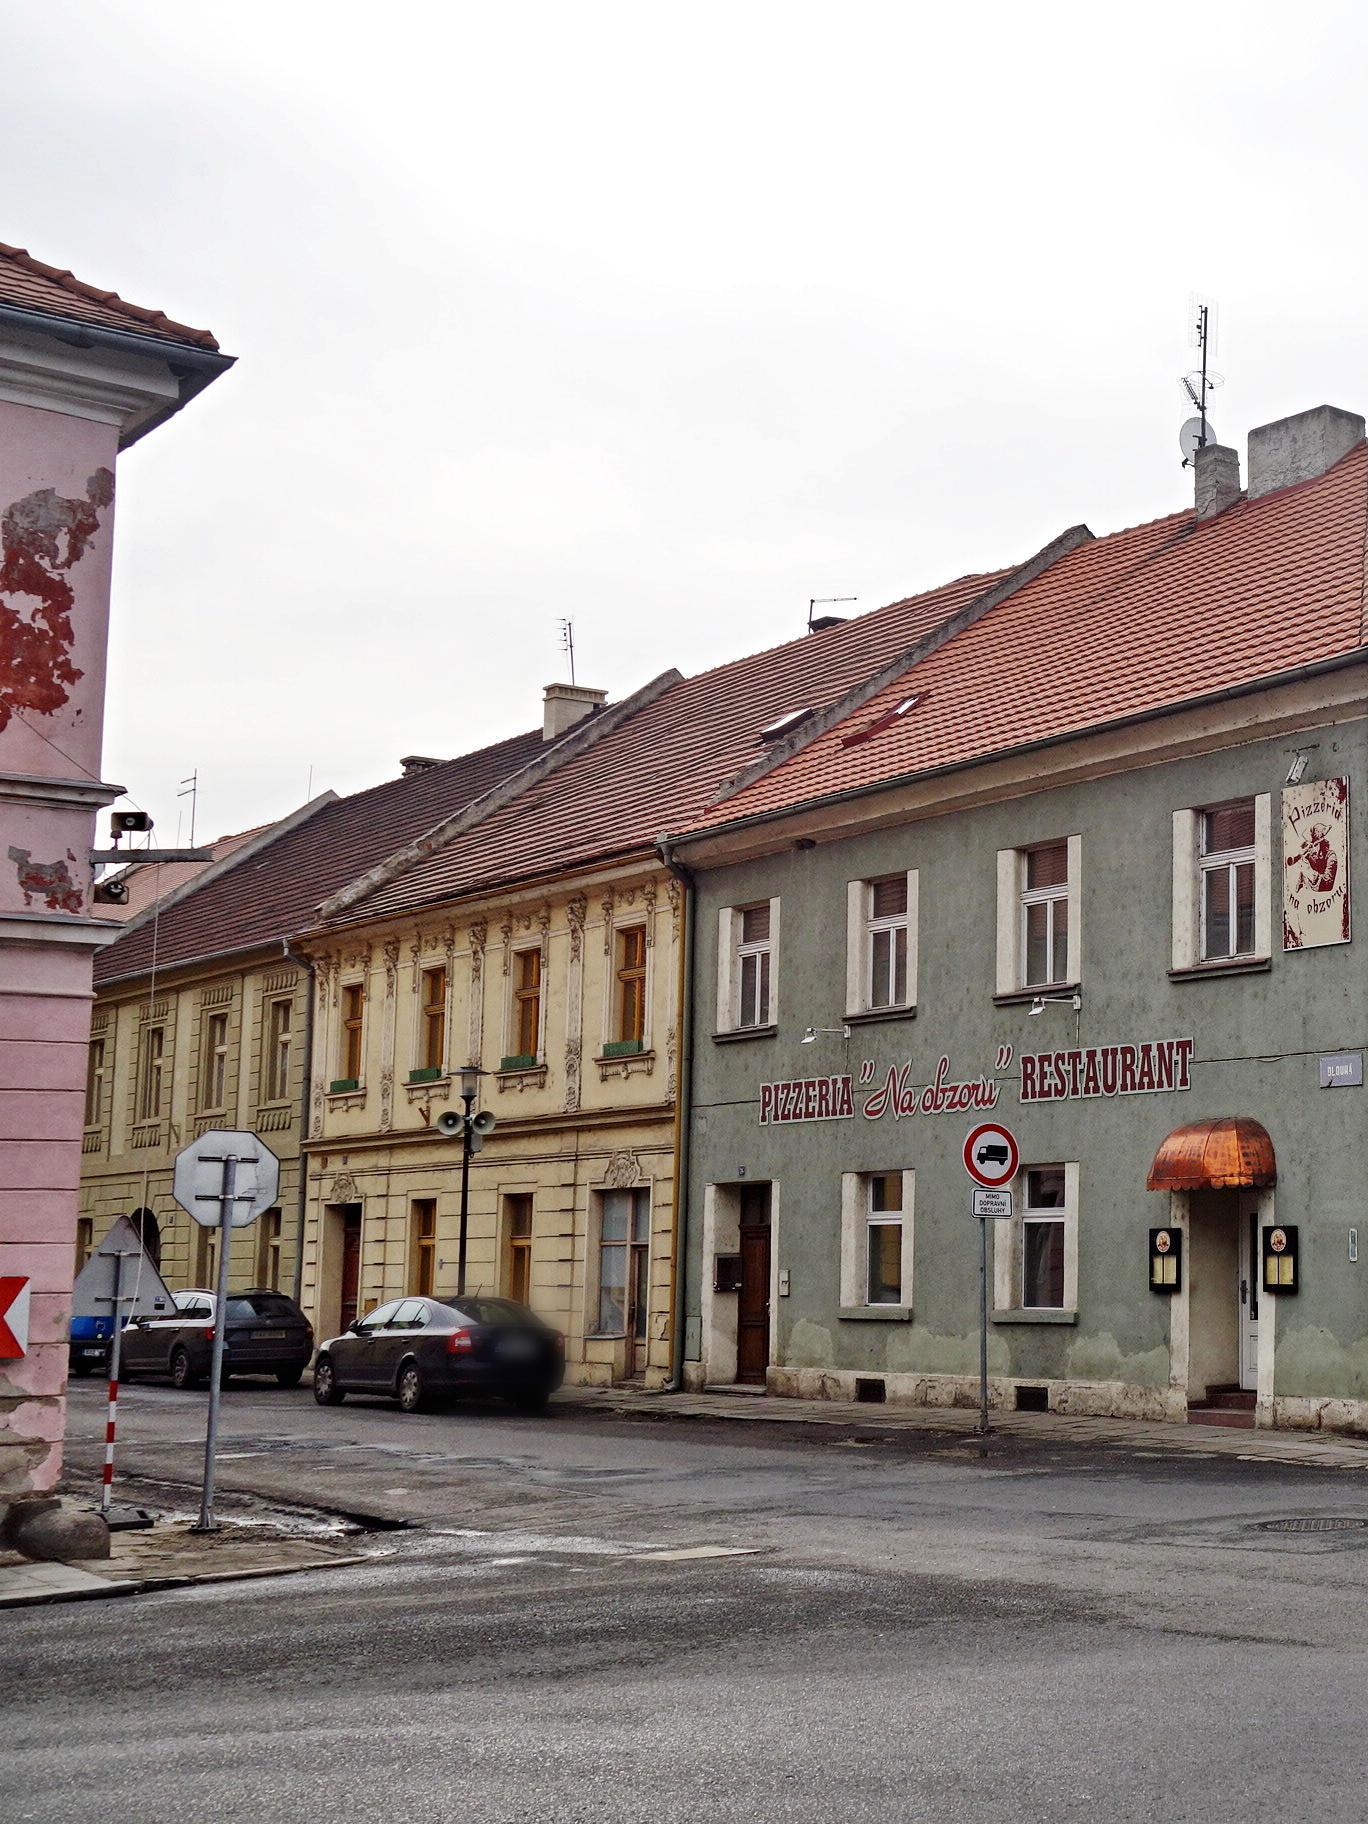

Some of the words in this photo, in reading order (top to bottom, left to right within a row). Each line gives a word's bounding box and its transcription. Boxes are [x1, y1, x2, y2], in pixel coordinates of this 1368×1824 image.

[1288, 802, 1341, 838] Pizzeria
[1307, 885, 1343, 914] obzoru
[760, 1076, 853, 1123] PIZZERIA
[1022, 1039, 1192, 1100] RESTAURANT
[979, 1199, 1007, 1207] DOPRAVNÍ
